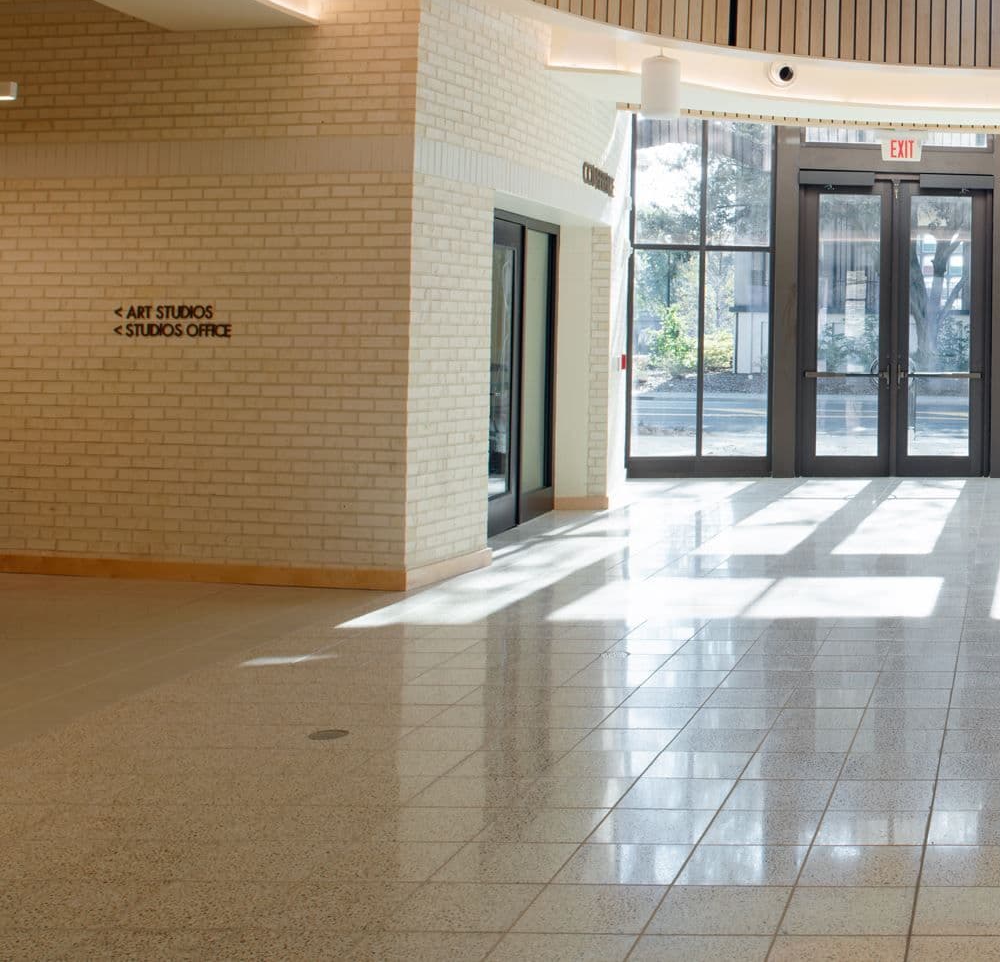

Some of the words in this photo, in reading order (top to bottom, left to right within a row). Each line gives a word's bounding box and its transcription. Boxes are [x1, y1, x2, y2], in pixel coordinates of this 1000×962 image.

[890, 139, 914, 158] EXIT
[126, 305, 152, 319] ART
[156, 305, 213, 319] STUDIOS
[125, 323, 183, 337] STUDIOS
[186, 323, 233, 338] OFFICE
